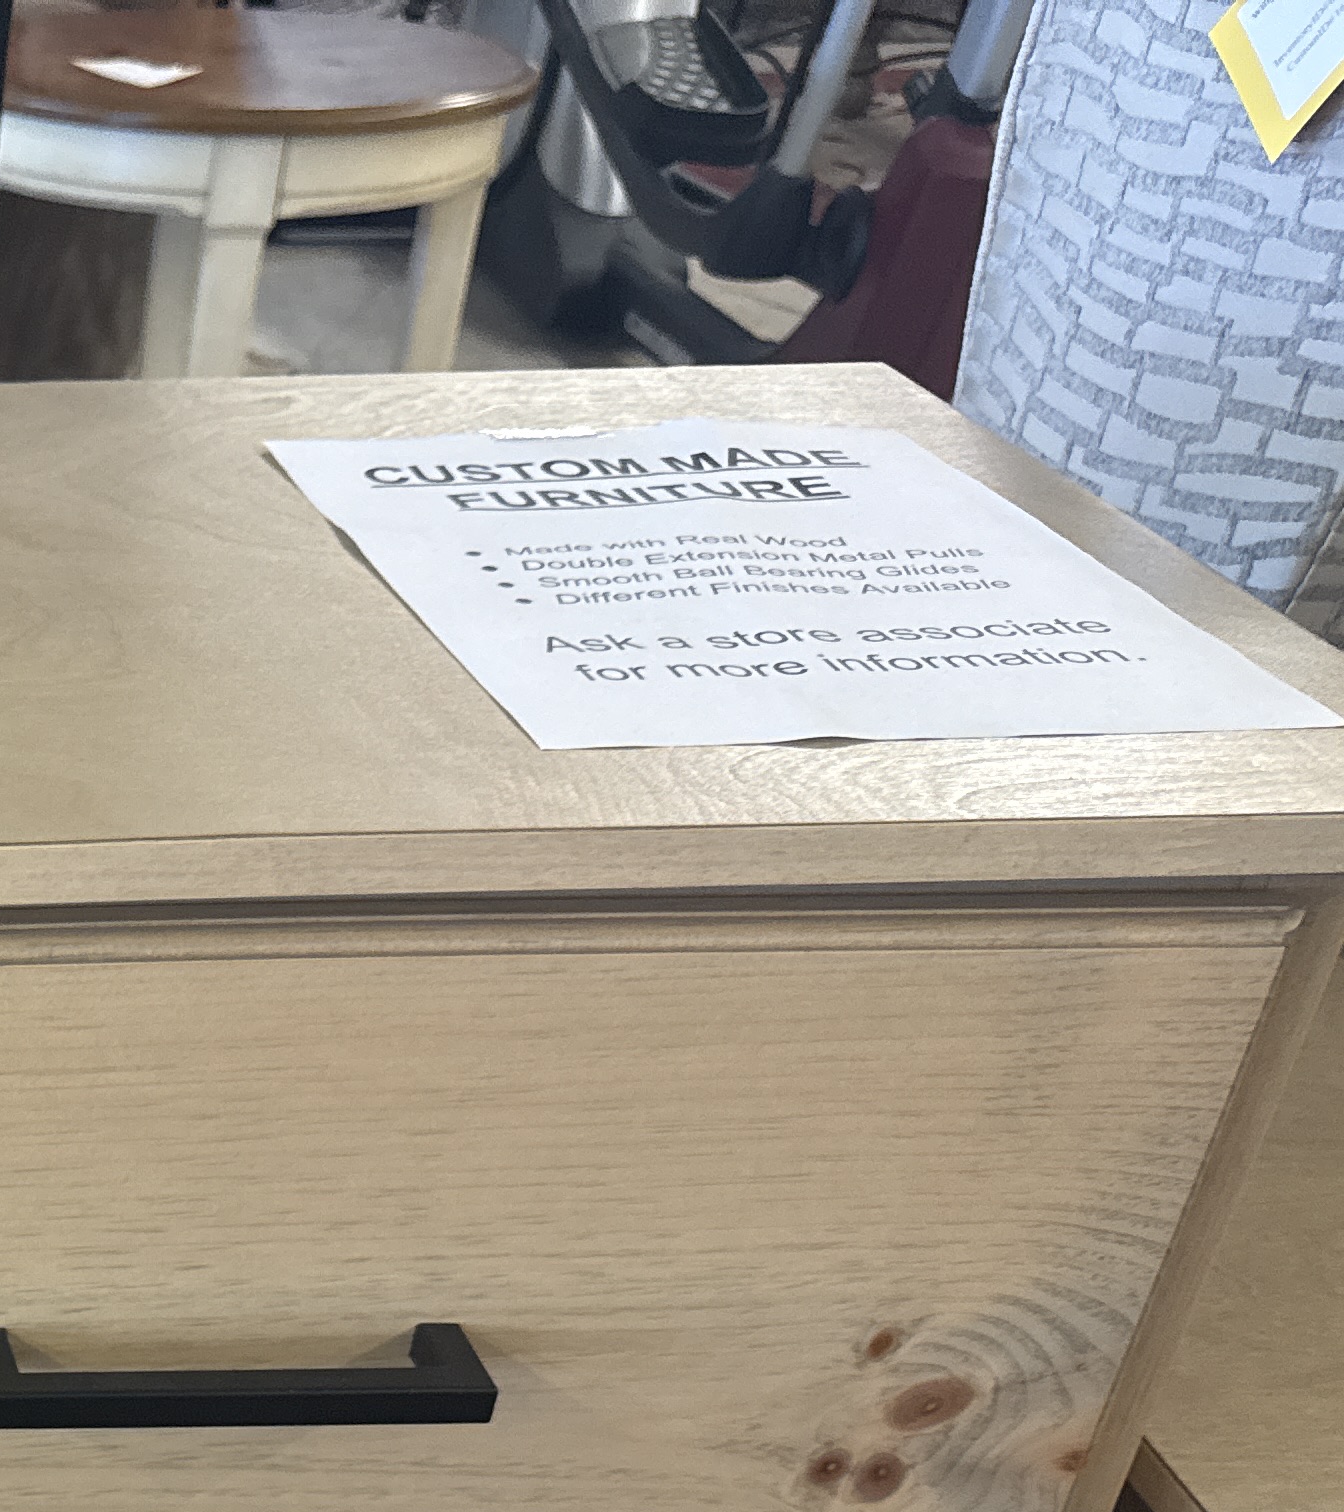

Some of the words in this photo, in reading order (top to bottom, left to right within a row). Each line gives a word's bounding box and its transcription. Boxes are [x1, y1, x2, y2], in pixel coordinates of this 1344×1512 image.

[364, 457, 649, 485] CUSTOM
[660, 447, 862, 473] MADE
[446, 475, 843, 510] FURNITURE
[504, 543, 593, 557] Made
[601, 537, 667, 550] with
[674, 534, 748, 546] Real
[755, 534, 849, 548] Wood
[521, 556, 634, 572] Double
[644, 549, 800, 566] Extension
[808, 549, 897, 563] Metal
[904, 547, 984, 560] Pulls
[538, 571, 664, 588] Smooth
[672, 564, 734, 580] Ball
[743, 564, 867, 581] Bearing
[875, 563, 980, 578] Glides
[555, 584, 702, 606] Different
[709, 580, 851, 596] Finishes
[861, 578, 1011, 596] Available
[545, 633, 648, 653] Ask
[657, 635, 694, 650] a
[705, 628, 843, 650] store
[856, 617, 1113, 643] associate
[574, 663, 648, 682] for
[665, 659, 810, 678] more
[816, 647, 1147, 673] information.
